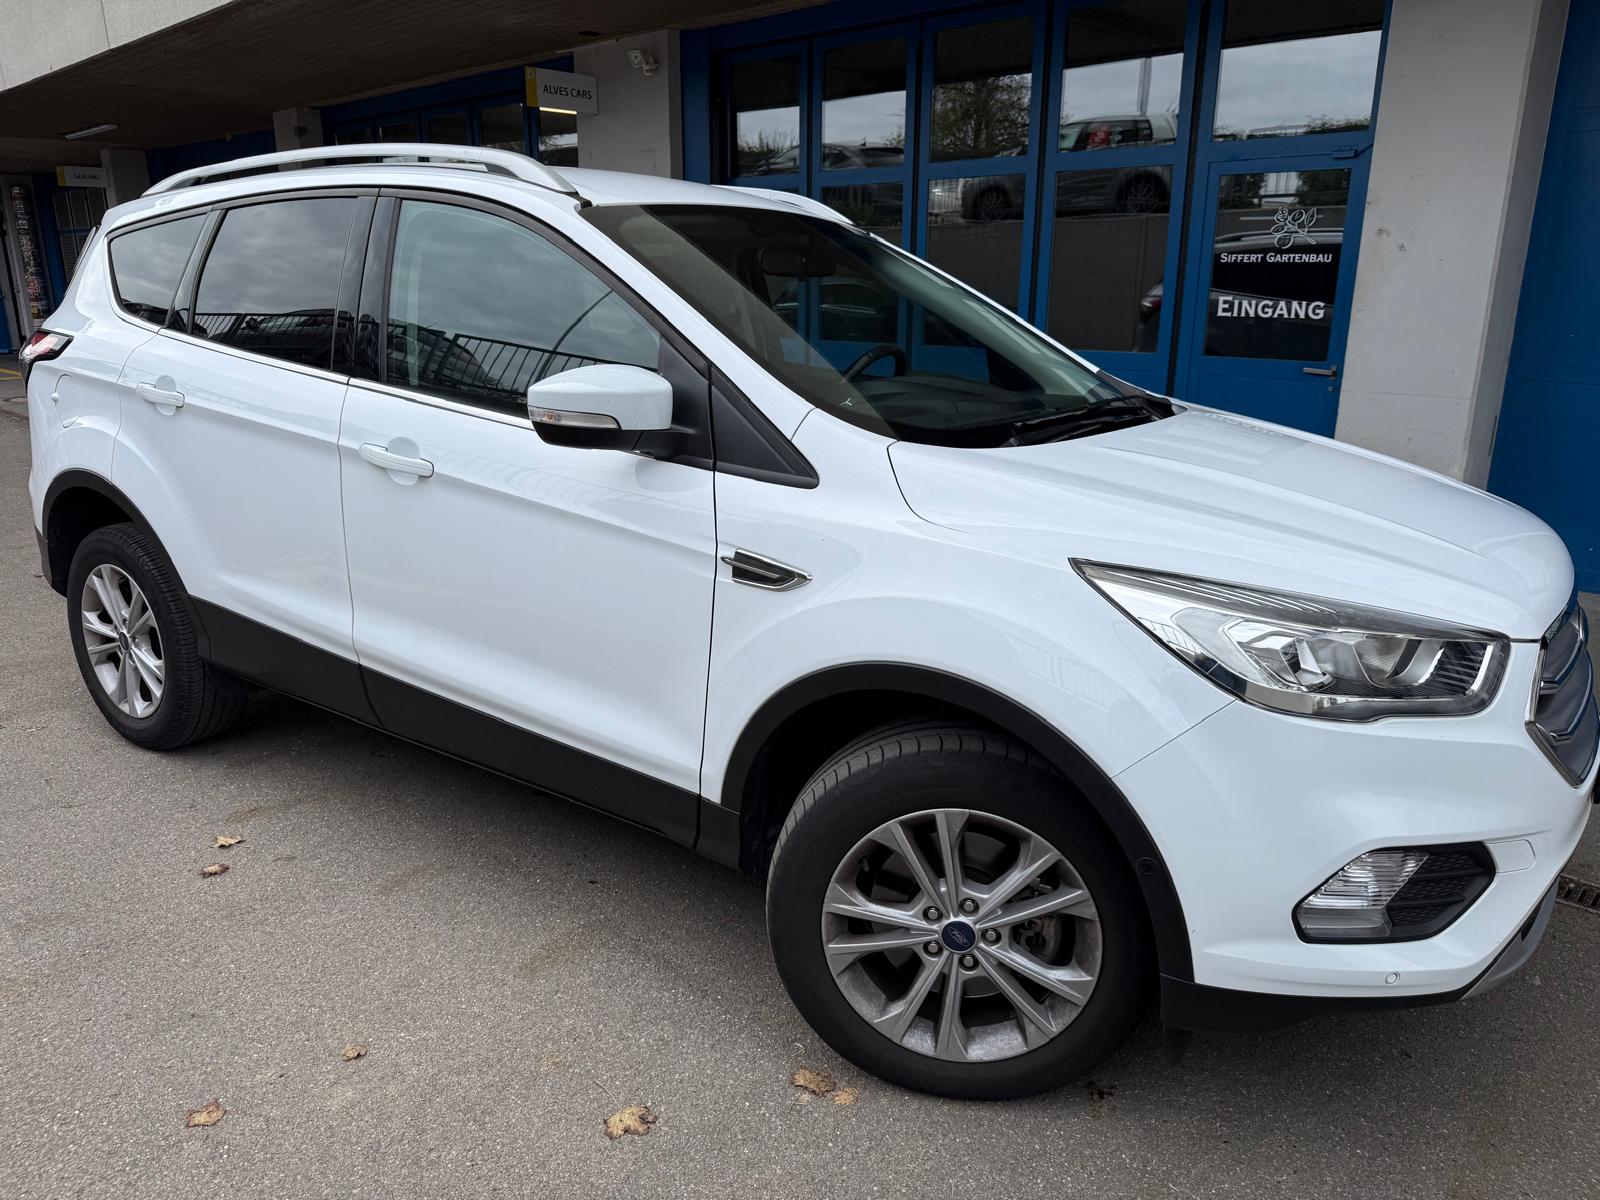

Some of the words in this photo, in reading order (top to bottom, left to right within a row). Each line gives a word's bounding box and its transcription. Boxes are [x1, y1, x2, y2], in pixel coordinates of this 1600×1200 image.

[543, 84, 569, 97] ALVES
[570, 87, 593, 100] CARS
[1220, 252, 1263, 263] SIFFERT
[1266, 252, 1332, 263] GARTENBAU
[1217, 296, 1325, 320] EINGANG
